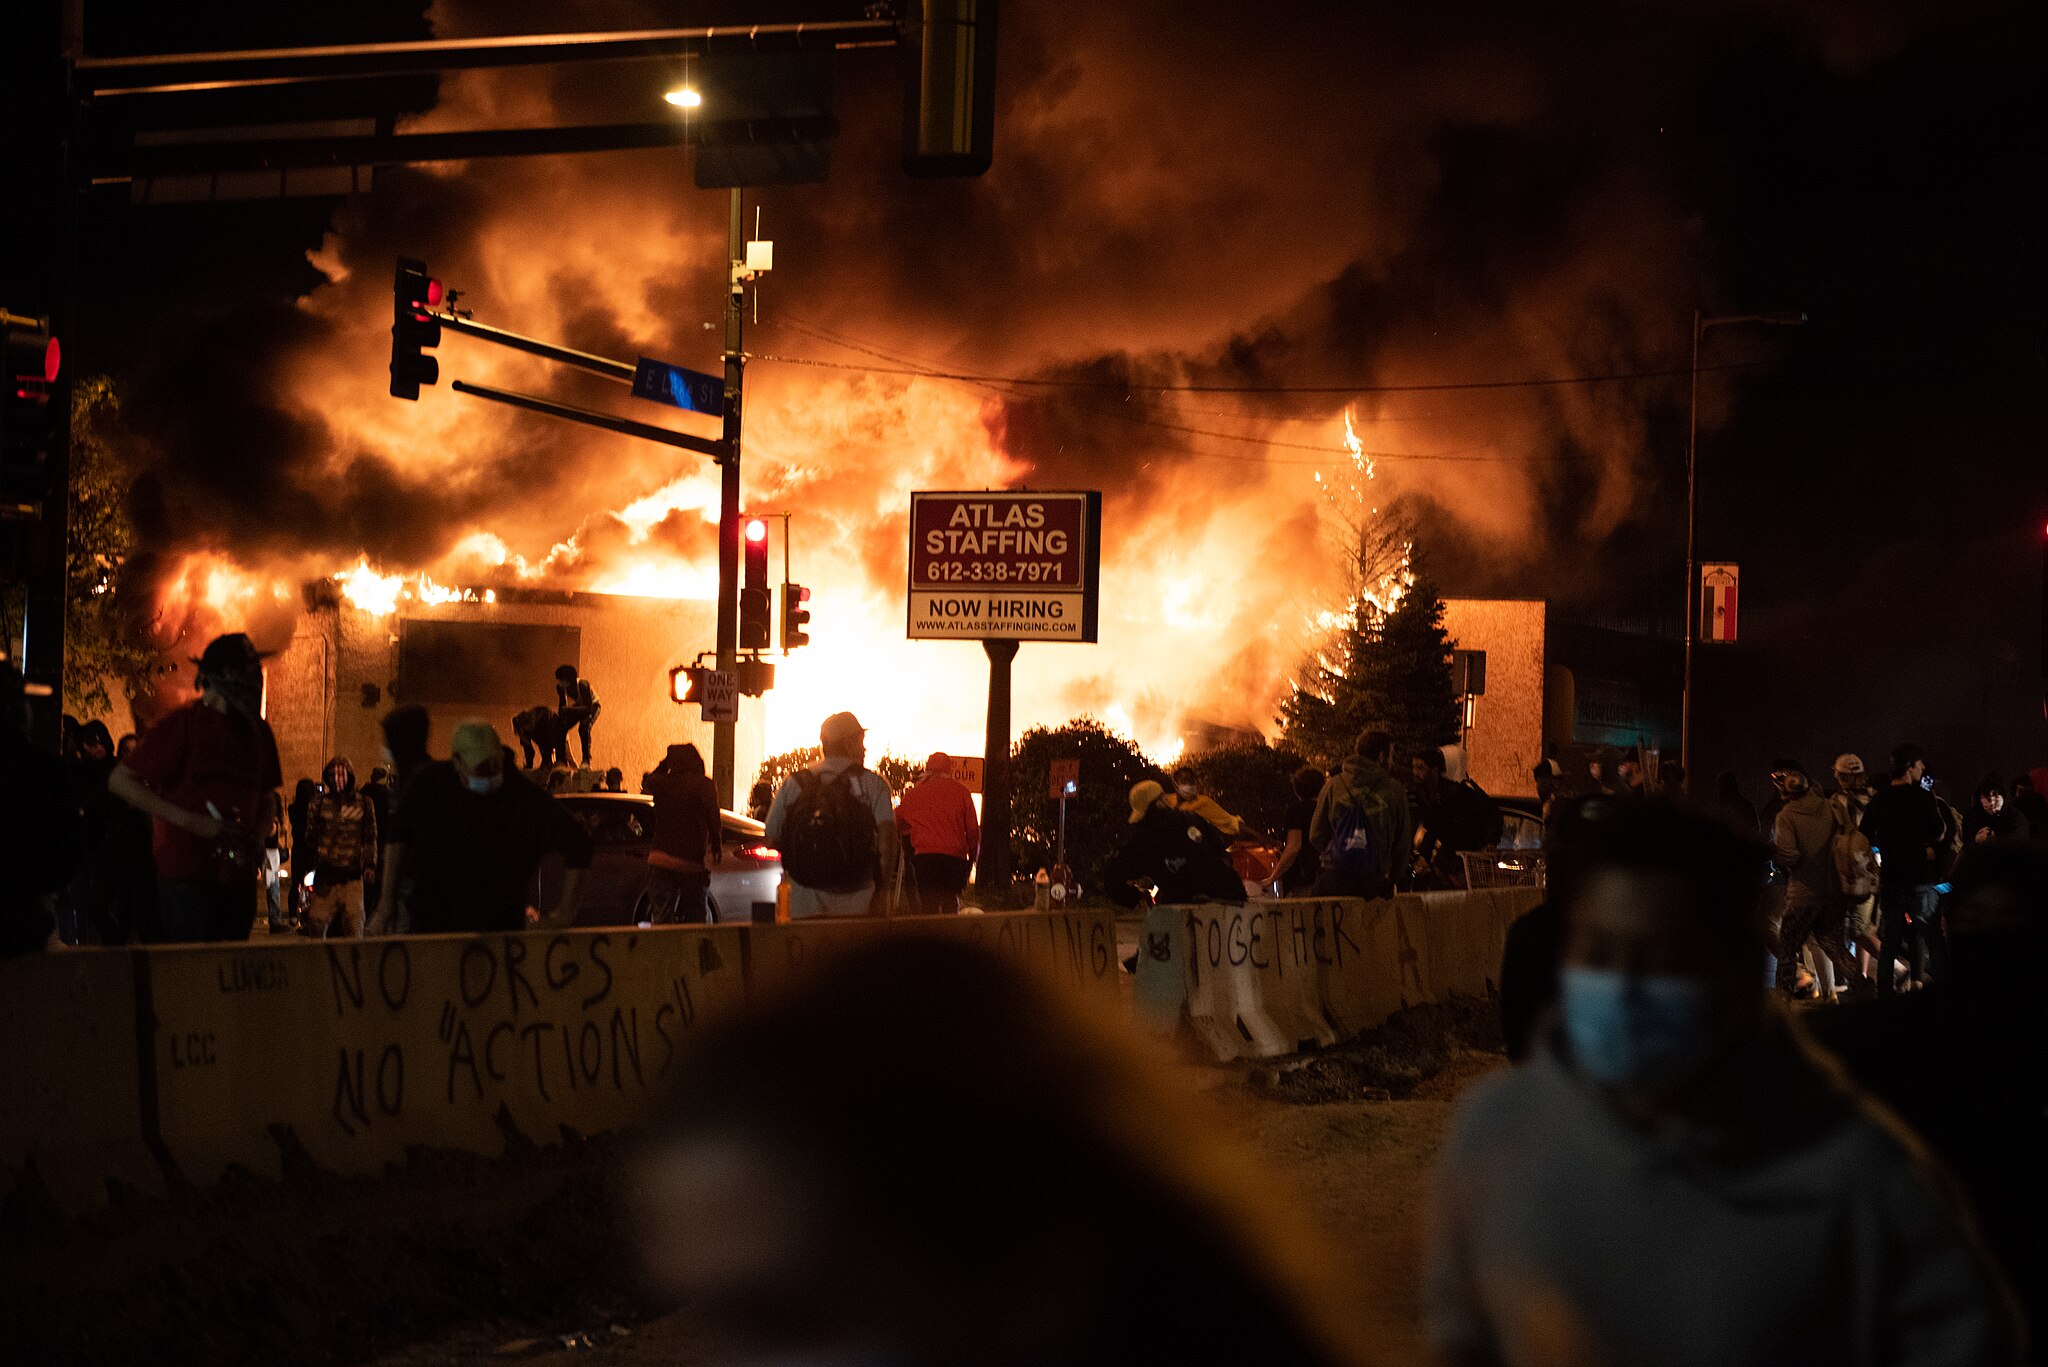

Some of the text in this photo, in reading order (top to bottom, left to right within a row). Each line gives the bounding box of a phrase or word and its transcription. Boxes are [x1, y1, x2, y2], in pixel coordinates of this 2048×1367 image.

[949, 503, 1045, 528] ATLAS
[926, 529, 1068, 555] STAFFING
[927, 561, 1062, 582] 612-338-7971
[929, 599, 1063, 619] NOW HIRING
[916, 620, 1077, 633] WWW.ATLASSTAFFINGINC.COM
[708, 673, 734, 686] ONE
[707, 688, 734, 701] WAY
[952, 769, 975, 782] OUR
[1187, 901, 1360, 986] TOGETHER
[326, 942, 412, 1015] NO
[170, 1030, 216, 1068] LCC
[333, 976, 694, 1136] NO "ACTIONS"
